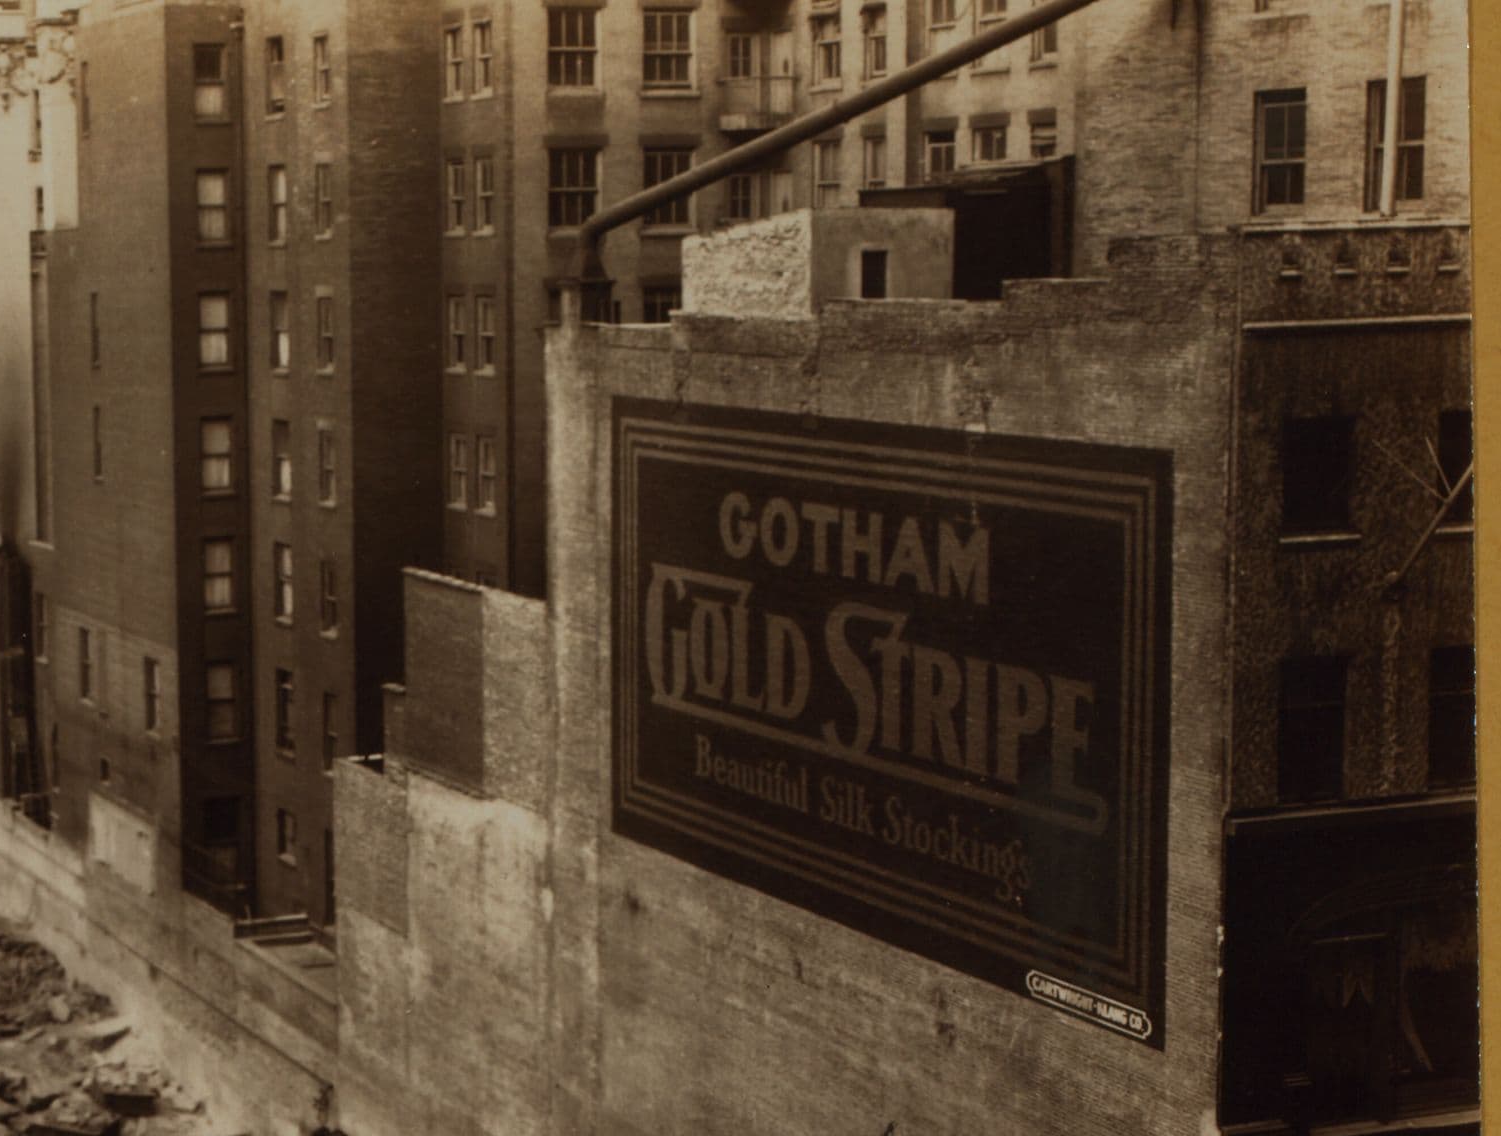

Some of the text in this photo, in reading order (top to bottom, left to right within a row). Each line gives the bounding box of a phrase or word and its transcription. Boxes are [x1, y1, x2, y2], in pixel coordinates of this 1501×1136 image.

[719, 491, 990, 605] GOTHAM
[646, 562, 1106, 802] GOLD STRIPE
[695, 733, 1032, 900] Beautiful Silk Stockings
